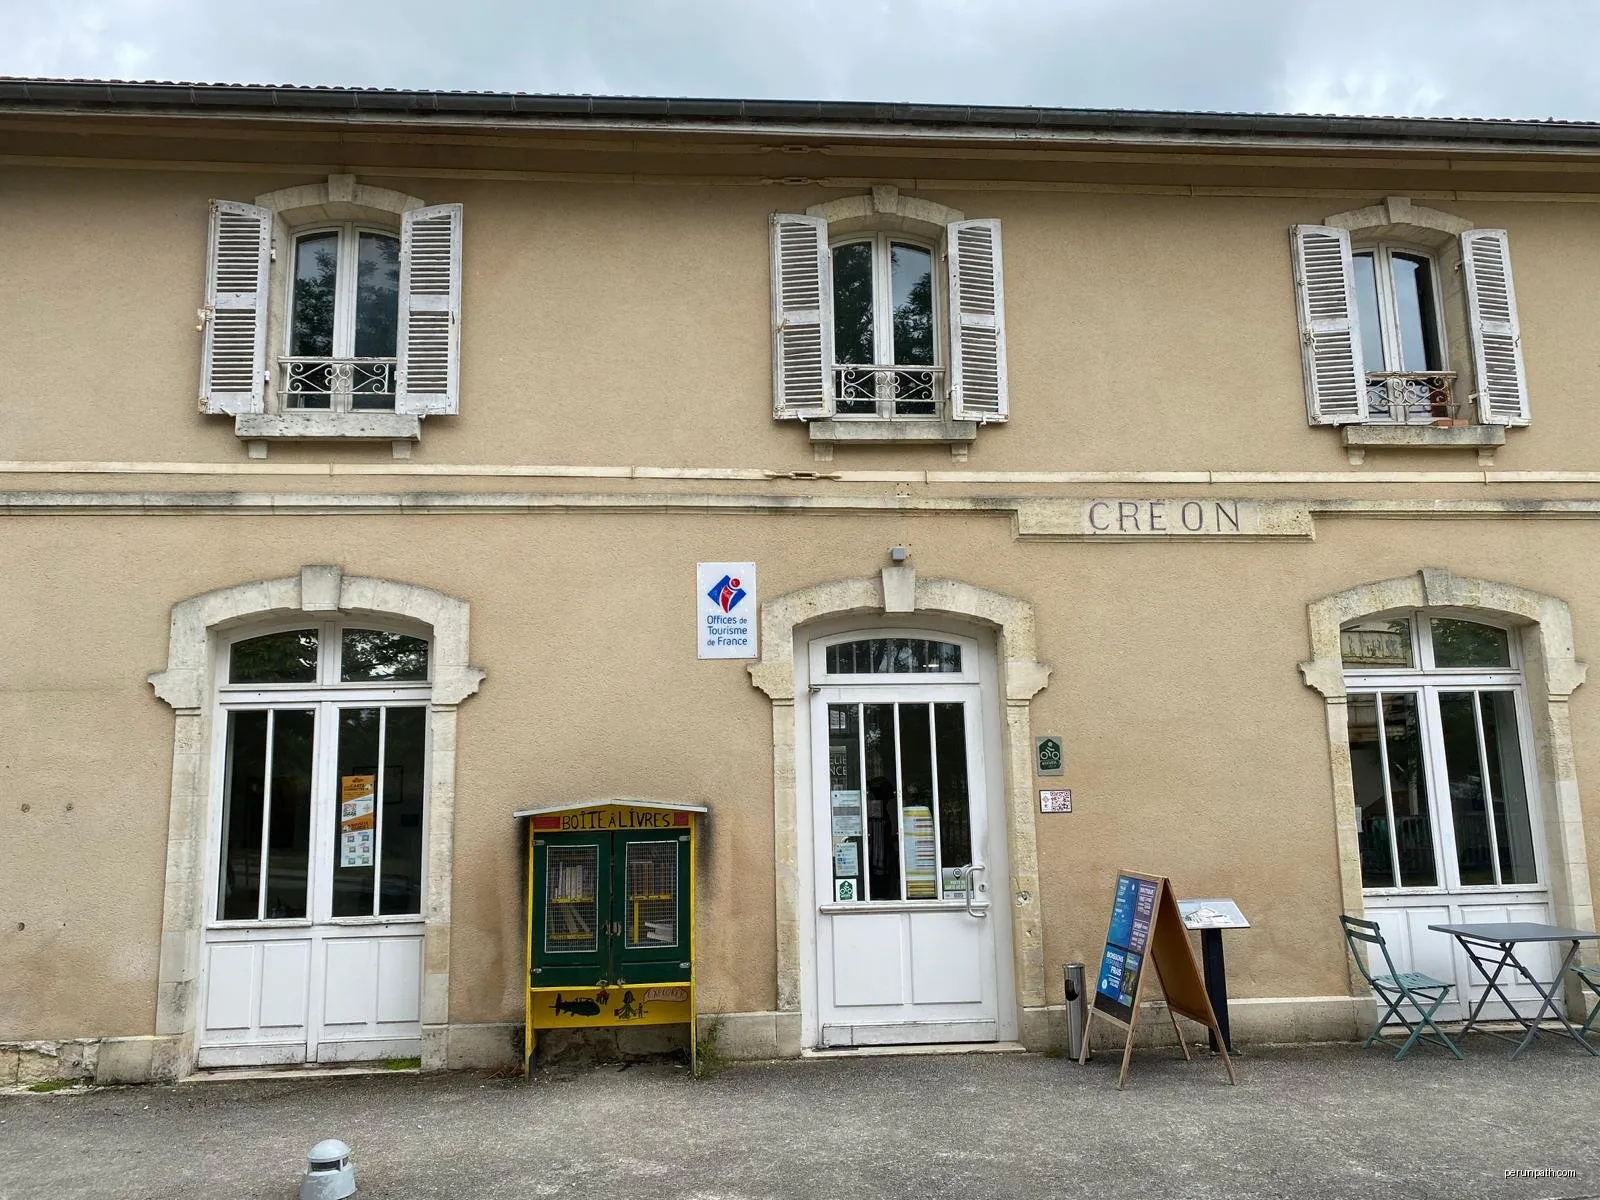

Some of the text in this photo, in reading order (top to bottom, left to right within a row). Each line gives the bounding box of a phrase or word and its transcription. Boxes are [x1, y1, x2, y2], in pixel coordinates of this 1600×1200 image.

[707, 615, 737, 624] Offices
[708, 626, 747, 635] Tourisme
[718, 637, 747, 646] France
